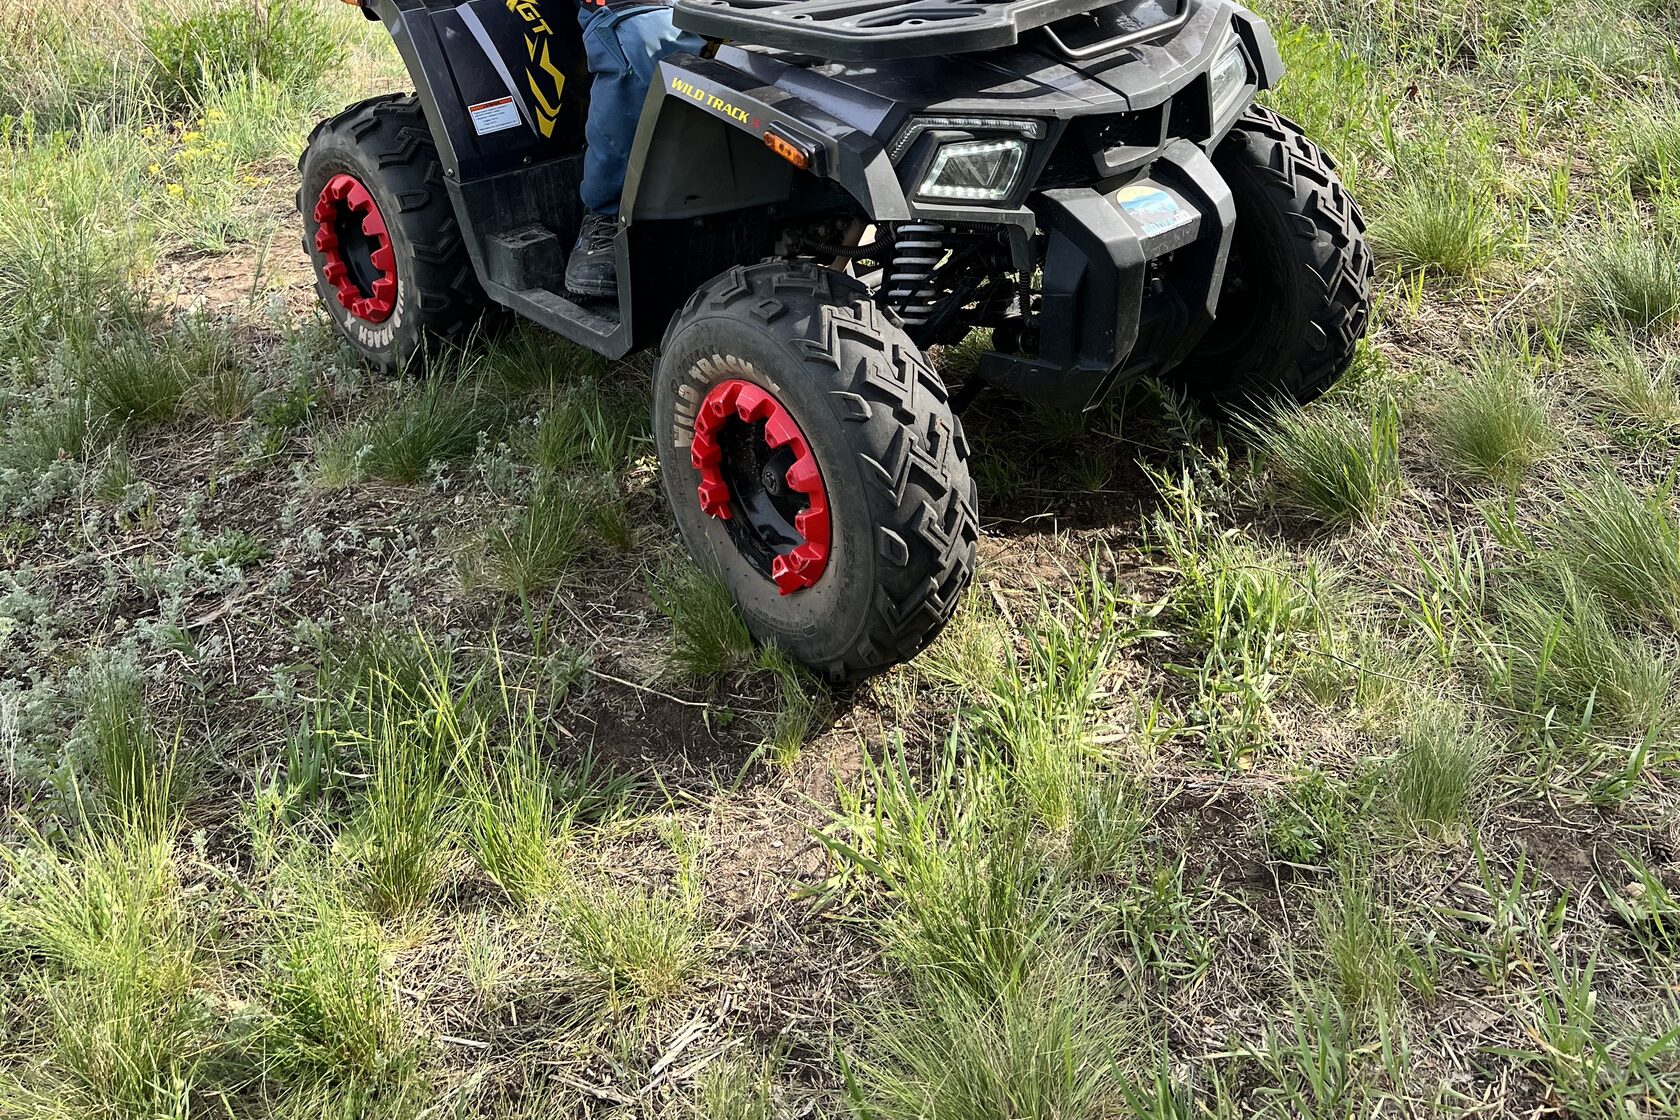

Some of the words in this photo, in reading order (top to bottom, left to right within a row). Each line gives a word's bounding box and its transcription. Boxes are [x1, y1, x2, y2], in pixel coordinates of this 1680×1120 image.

[671, 77, 705, 101] WILD
[706, 95, 750, 124] TRACK
[343, 310, 357, 333] X
[673, 384, 699, 448] WILD
